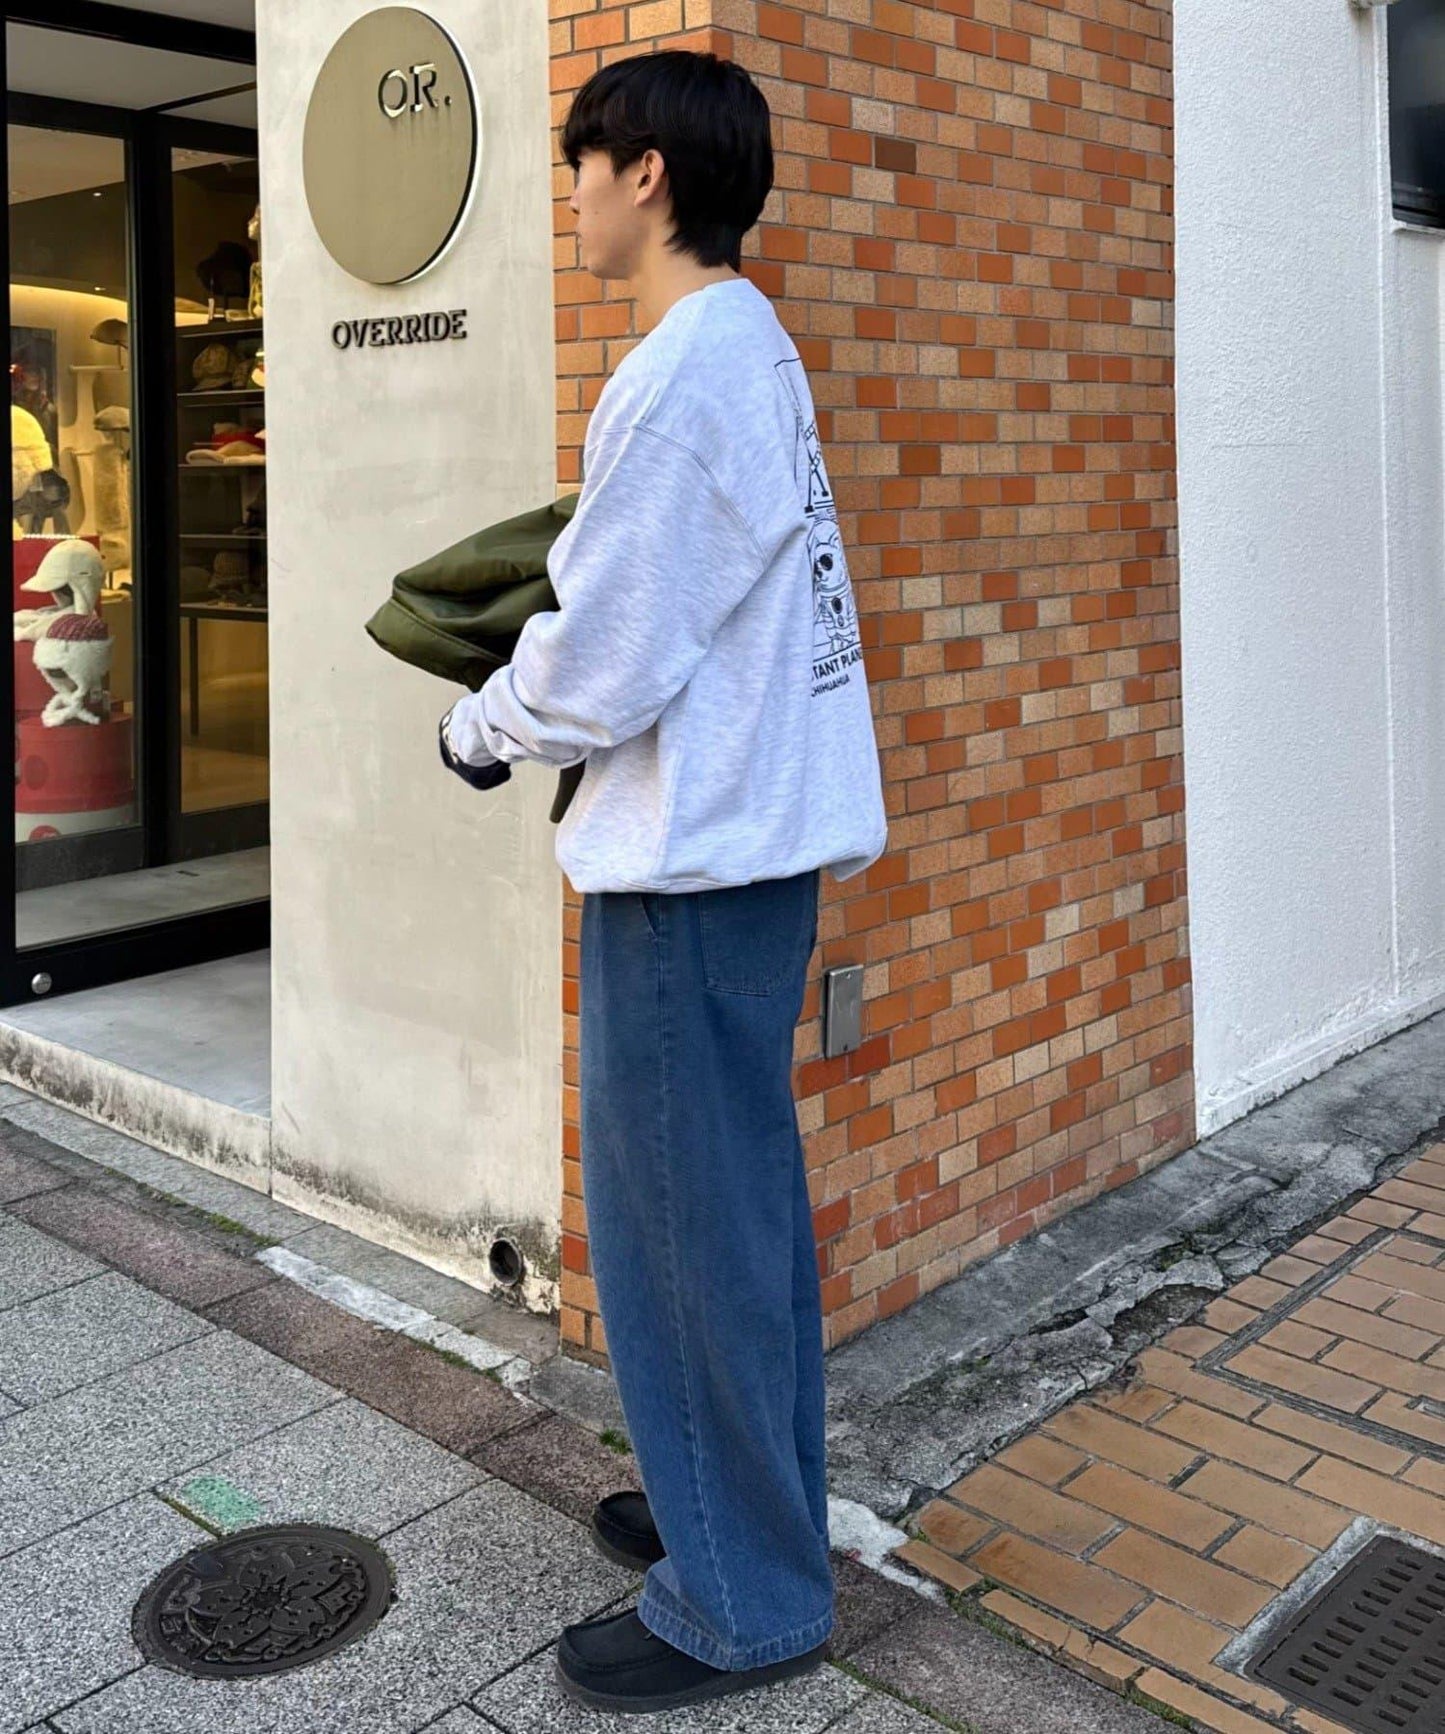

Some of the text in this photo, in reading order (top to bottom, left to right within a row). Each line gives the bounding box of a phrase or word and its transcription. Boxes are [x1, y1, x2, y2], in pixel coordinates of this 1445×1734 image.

[378, 62, 453, 118] OR.
[331, 309, 467, 349] OVERRIDE
[811, 658, 840, 681] TANT
